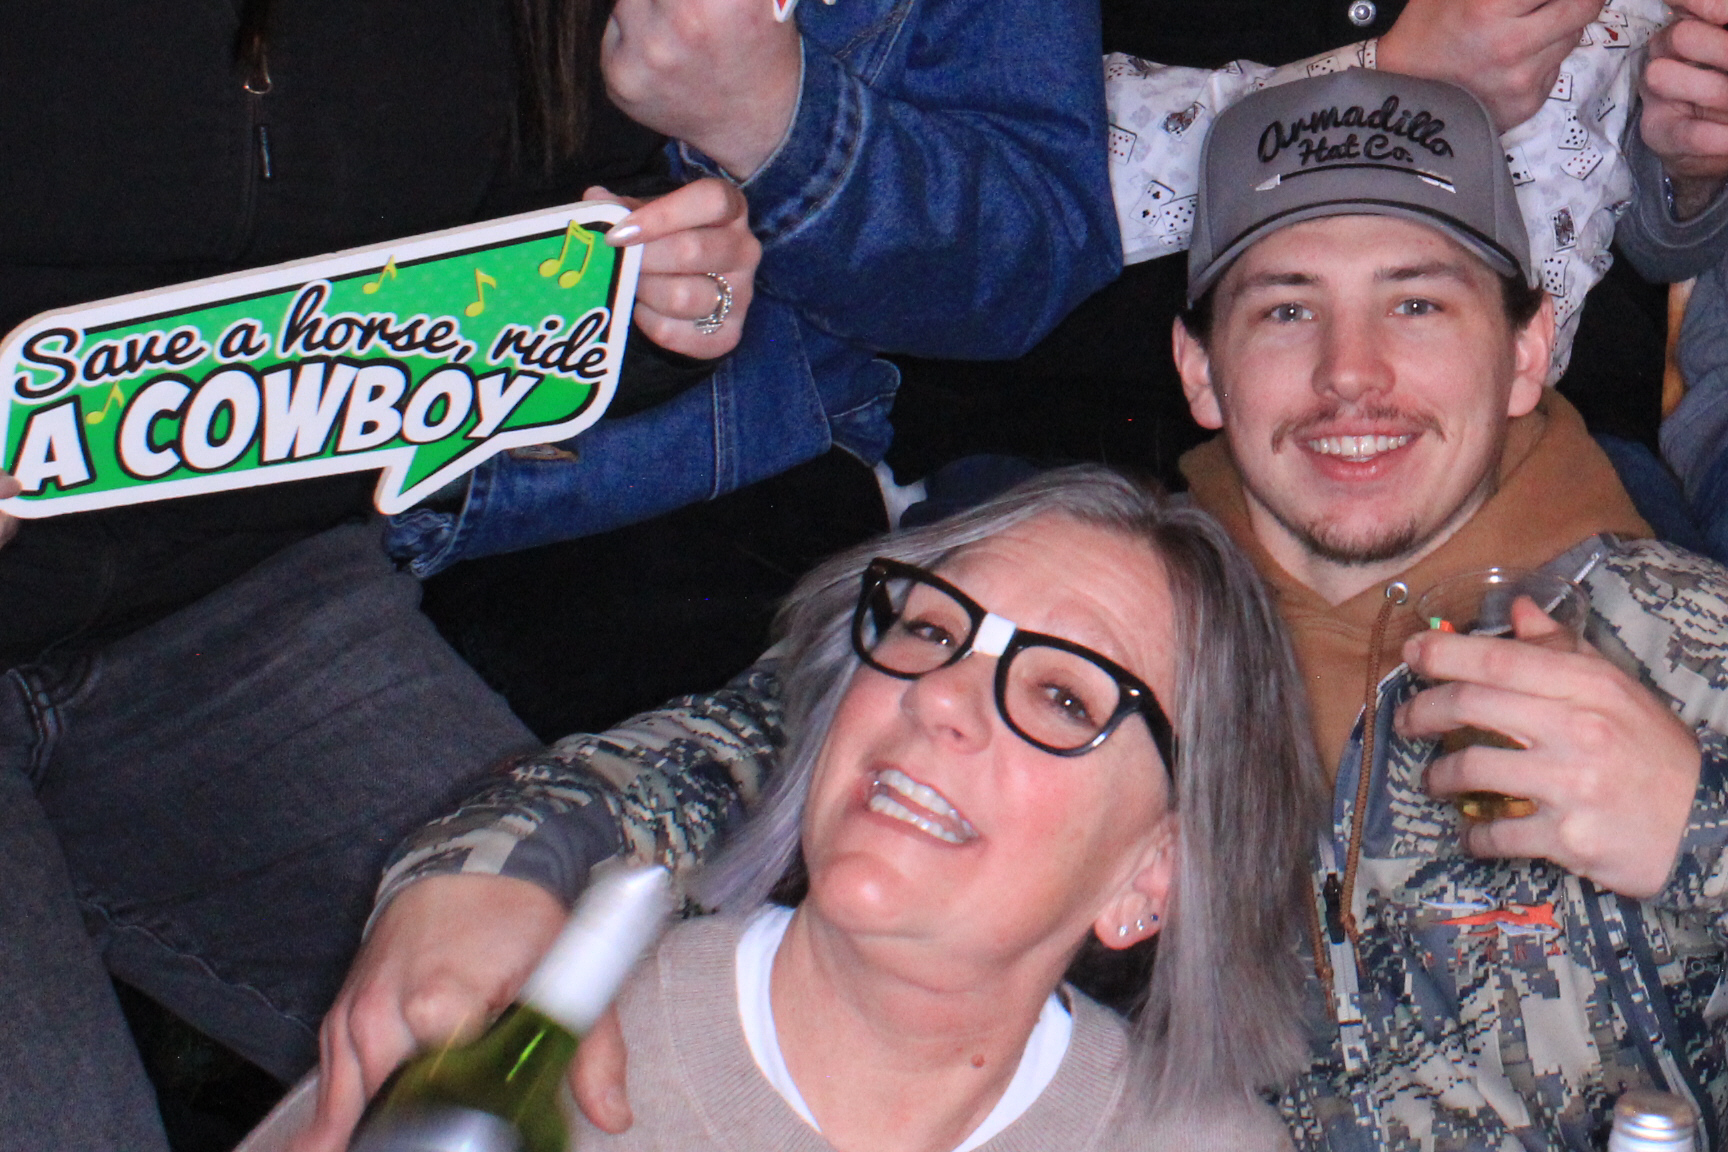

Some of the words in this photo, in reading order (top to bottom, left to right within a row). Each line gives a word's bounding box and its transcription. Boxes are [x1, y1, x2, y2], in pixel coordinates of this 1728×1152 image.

[1257, 94, 1455, 163] Armadillo
[1298, 133, 1360, 166] Hat
[1363, 133, 1414, 163] Co.
[14, 327, 208, 399] Save
[220, 322, 267, 359] a
[282, 284, 473, 362] horse,
[492, 311, 608, 378] ride
[9, 394, 97, 496] A
[115, 354, 545, 481] COWBOY
